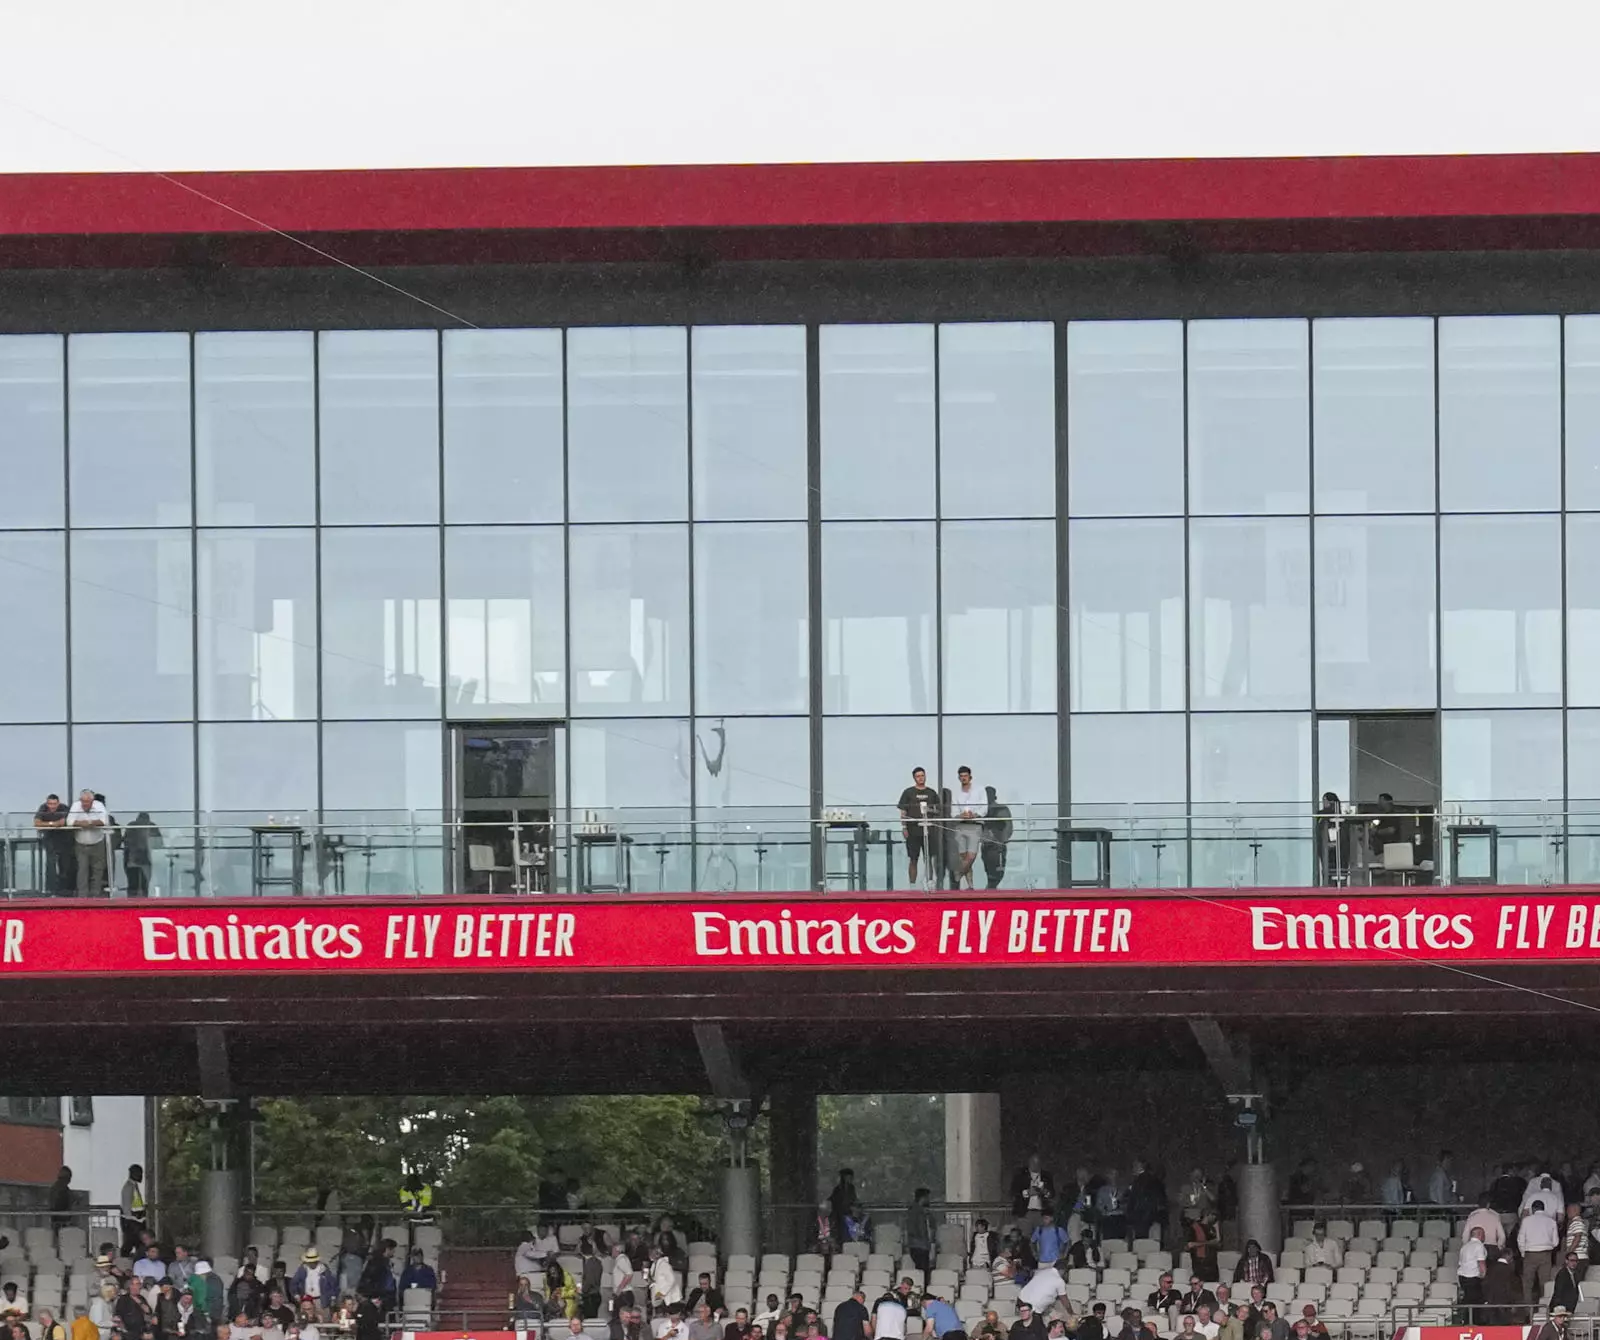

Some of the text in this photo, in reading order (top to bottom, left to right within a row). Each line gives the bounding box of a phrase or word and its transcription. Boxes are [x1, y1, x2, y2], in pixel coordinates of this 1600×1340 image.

[139, 914, 575, 961] Emirates FLY BETTER
[692, 909, 1131, 956] Emirates FLY BETTER
[1250, 904, 1473, 950] Emirates
[1496, 905, 1554, 949] FLY
